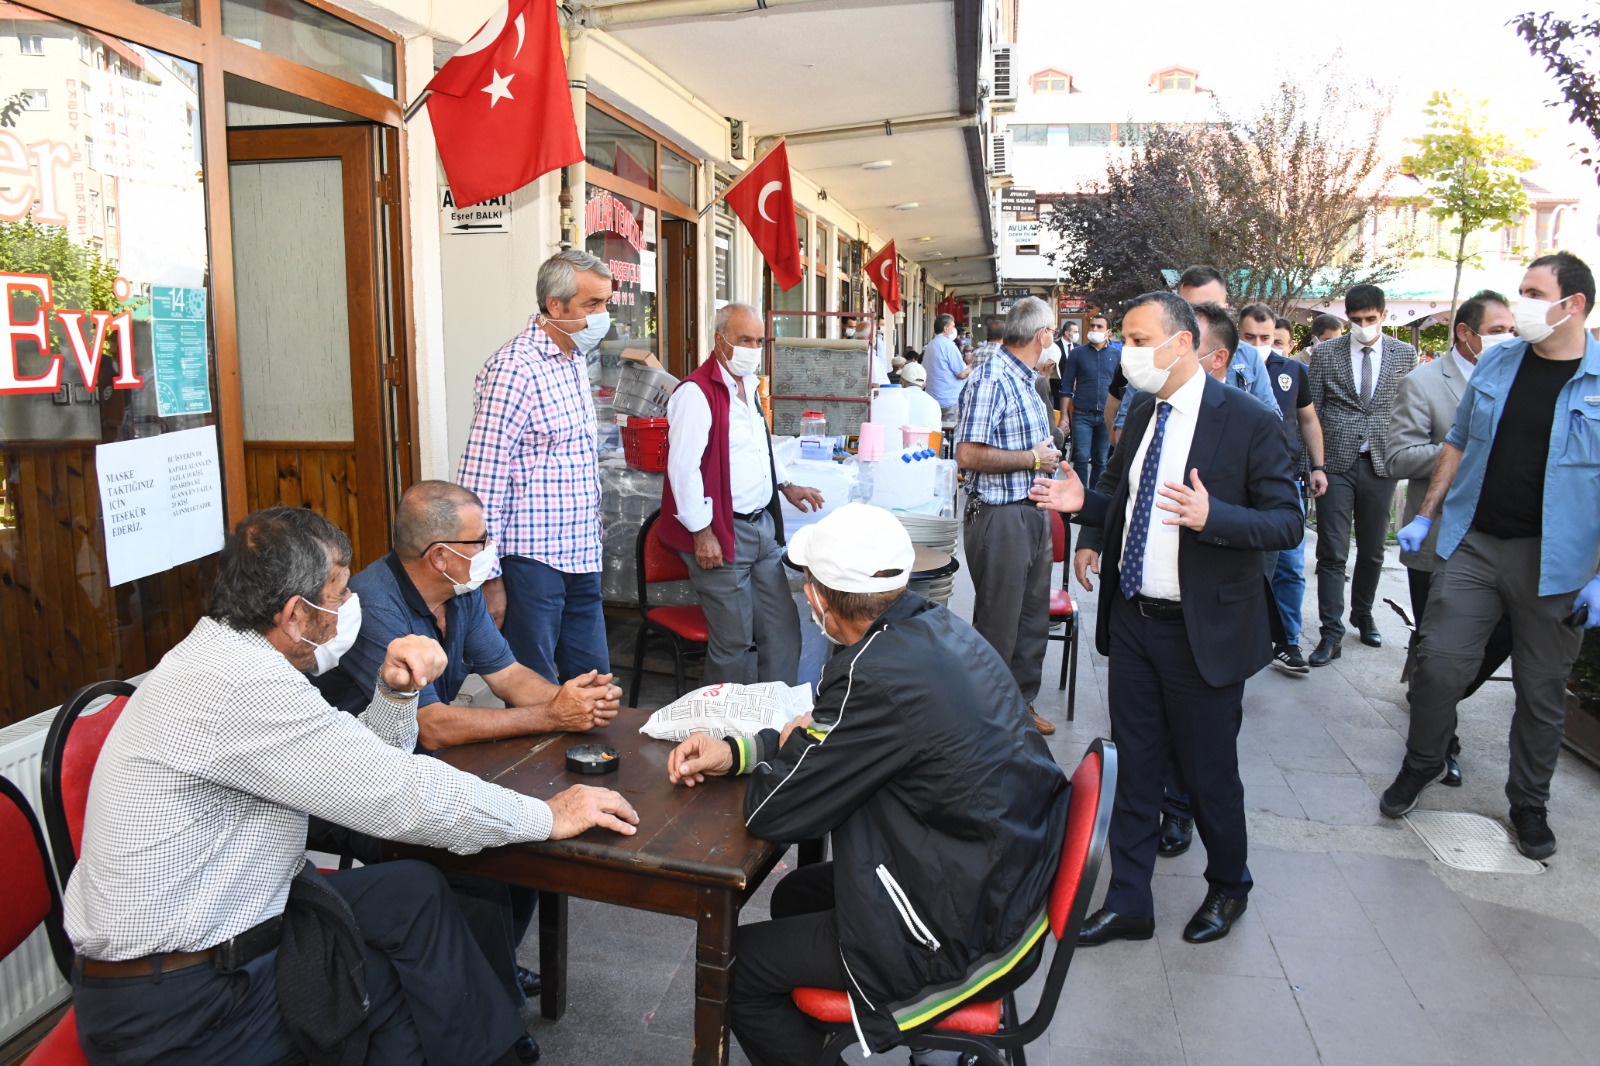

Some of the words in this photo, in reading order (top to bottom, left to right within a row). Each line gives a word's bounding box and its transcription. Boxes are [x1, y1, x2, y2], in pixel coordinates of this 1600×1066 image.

[451, 212, 474, 221] Eşref
[476, 210, 502, 220] BALKİ
[168, 287, 186, 312] 14
[0, 271, 144, 395] Evi
[106, 469, 135, 483] MASKE
[107, 479, 155, 497] TAKTIĞINIZ
[108, 497, 126, 511] İÇİN
